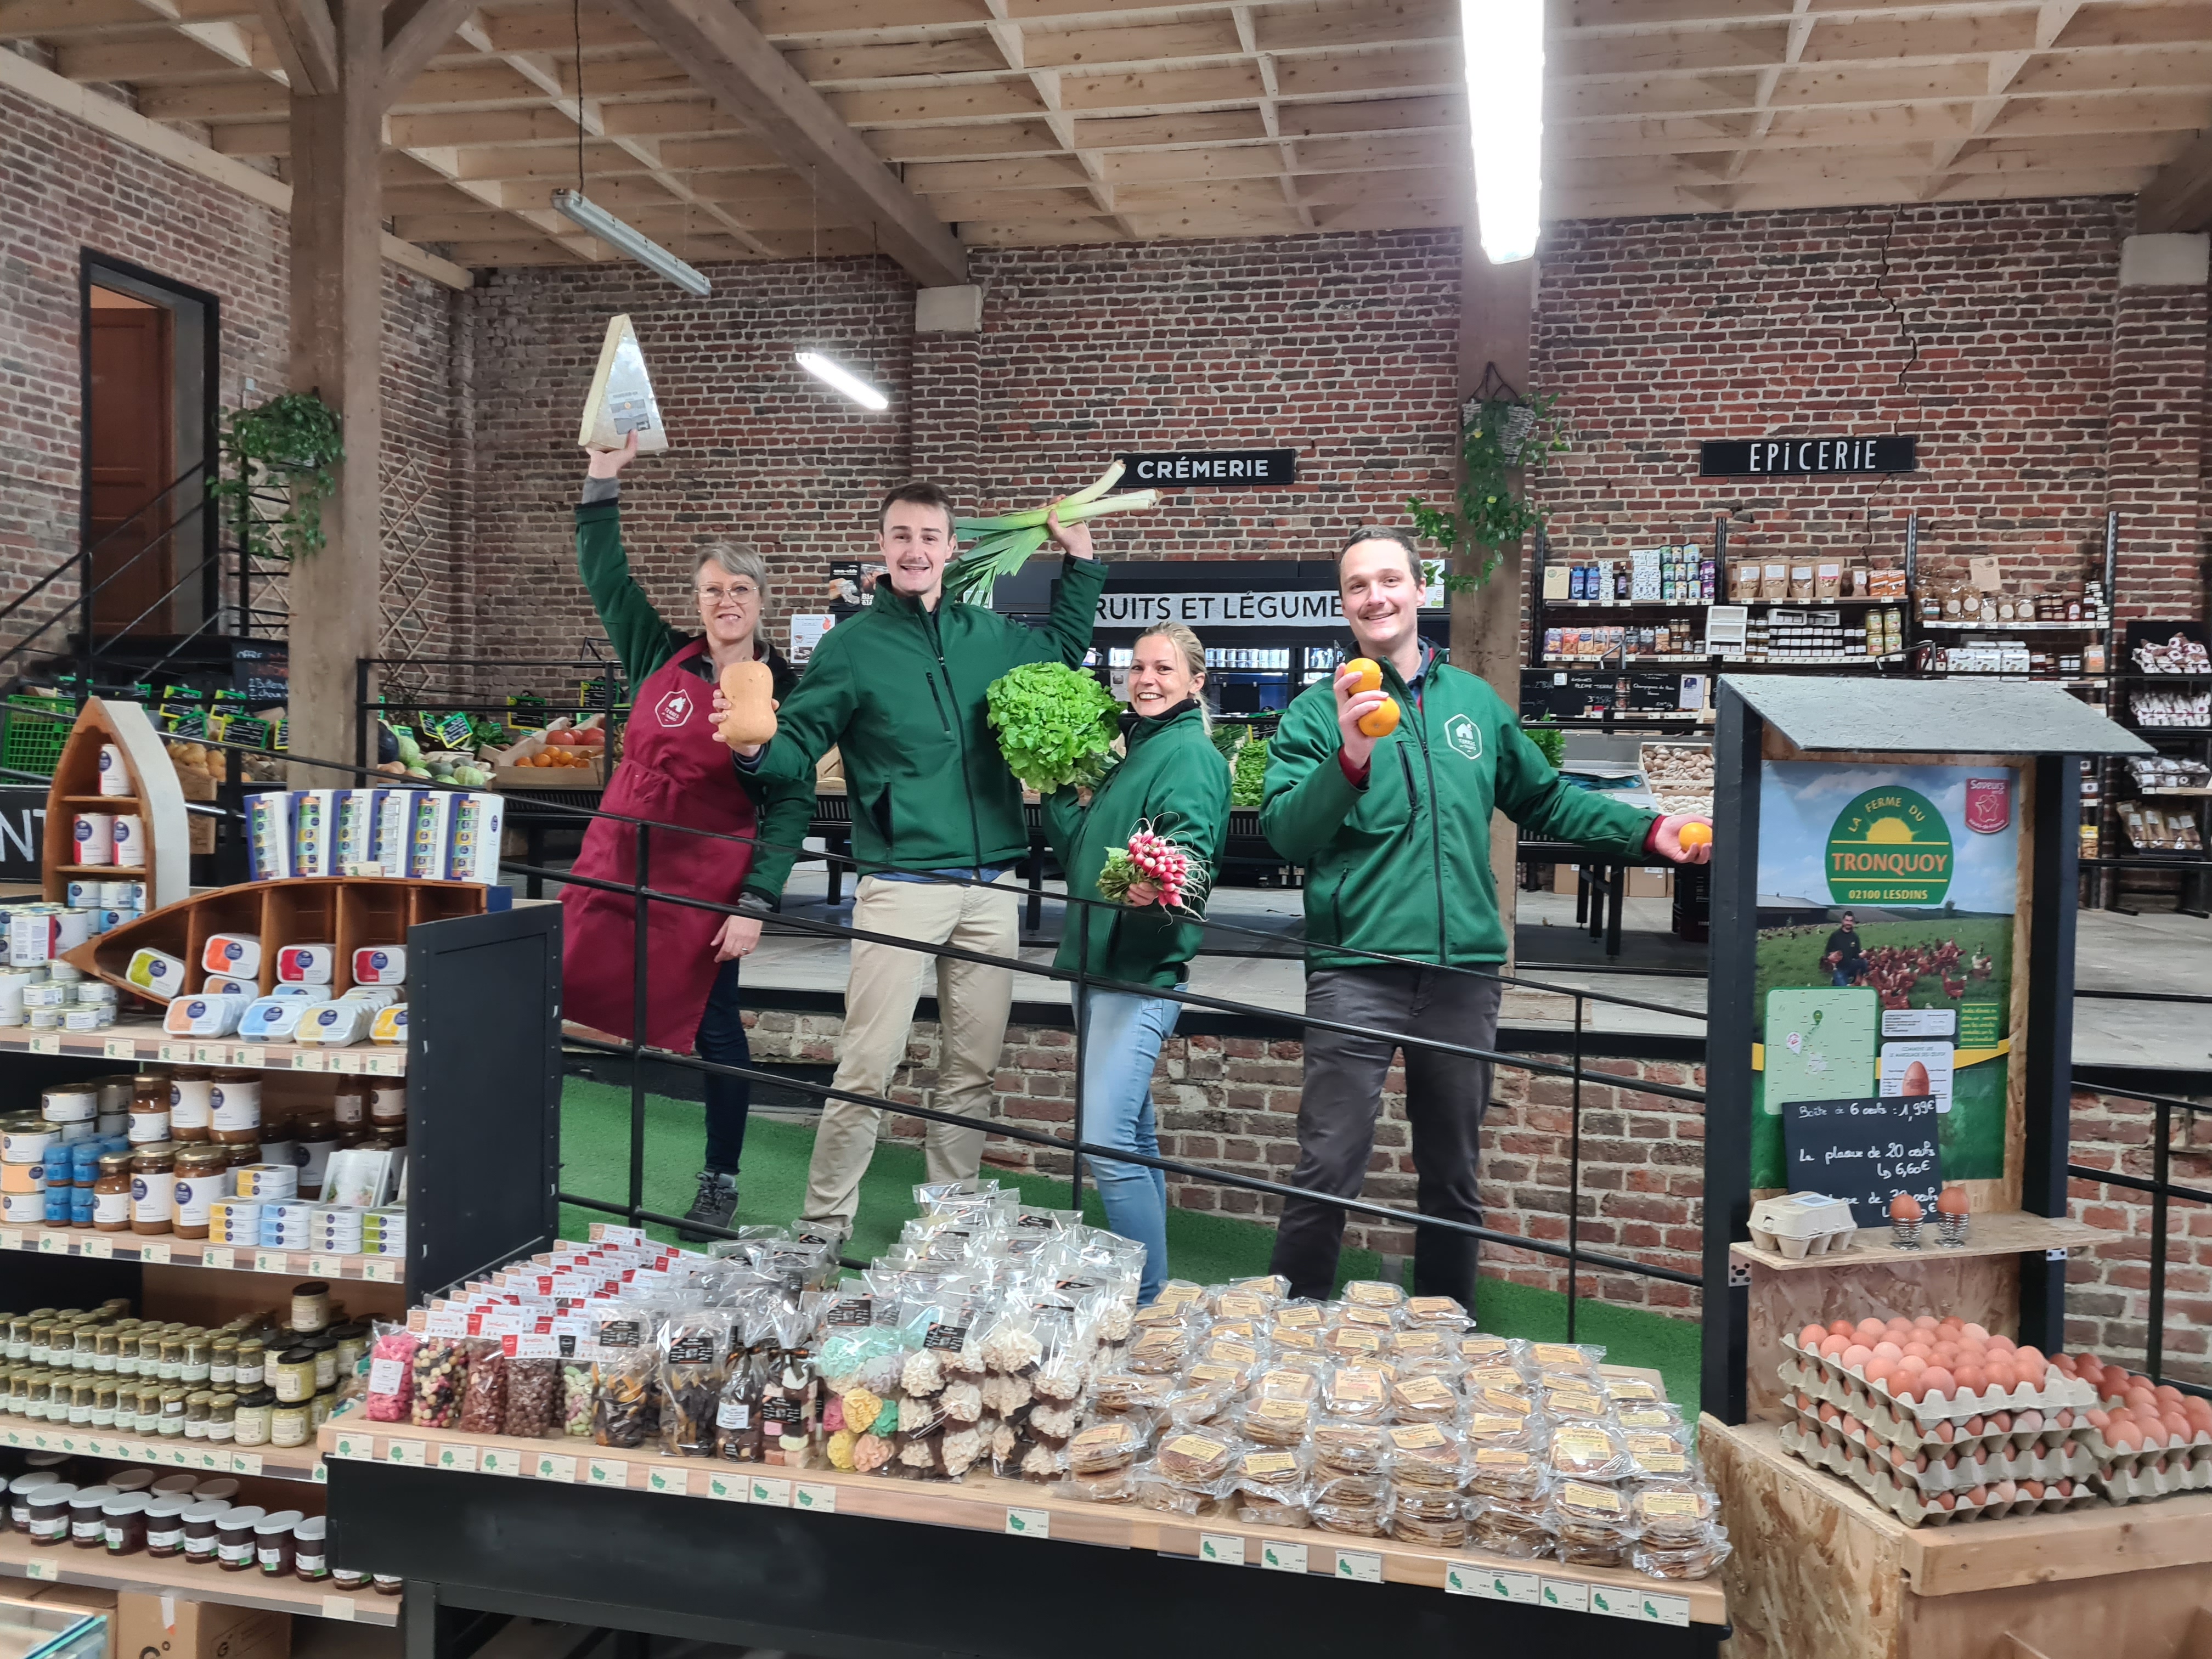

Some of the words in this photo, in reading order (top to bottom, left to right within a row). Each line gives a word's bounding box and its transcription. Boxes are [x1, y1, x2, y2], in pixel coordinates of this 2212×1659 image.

[1137, 456, 1268, 479] CRÉMERIE
[1182, 597, 1215, 619] ET
[1848, 817, 1862, 832] LA
[1865, 797, 1902, 812] FERME
[1909, 805, 1926, 822] DU
[1831, 853, 1947, 876] TRONQUOY
[1848, 890, 1881, 900] 02100
[1883, 890, 1928, 900] LESDINS
[1850, 1102, 1859, 1115] 6
[1867, 1146, 1881, 1158] de
[1885, 1142, 1904, 1158] 20
[1895, 1160, 1931, 1178] 6,60€
[1868, 1192, 1883, 1204] de
